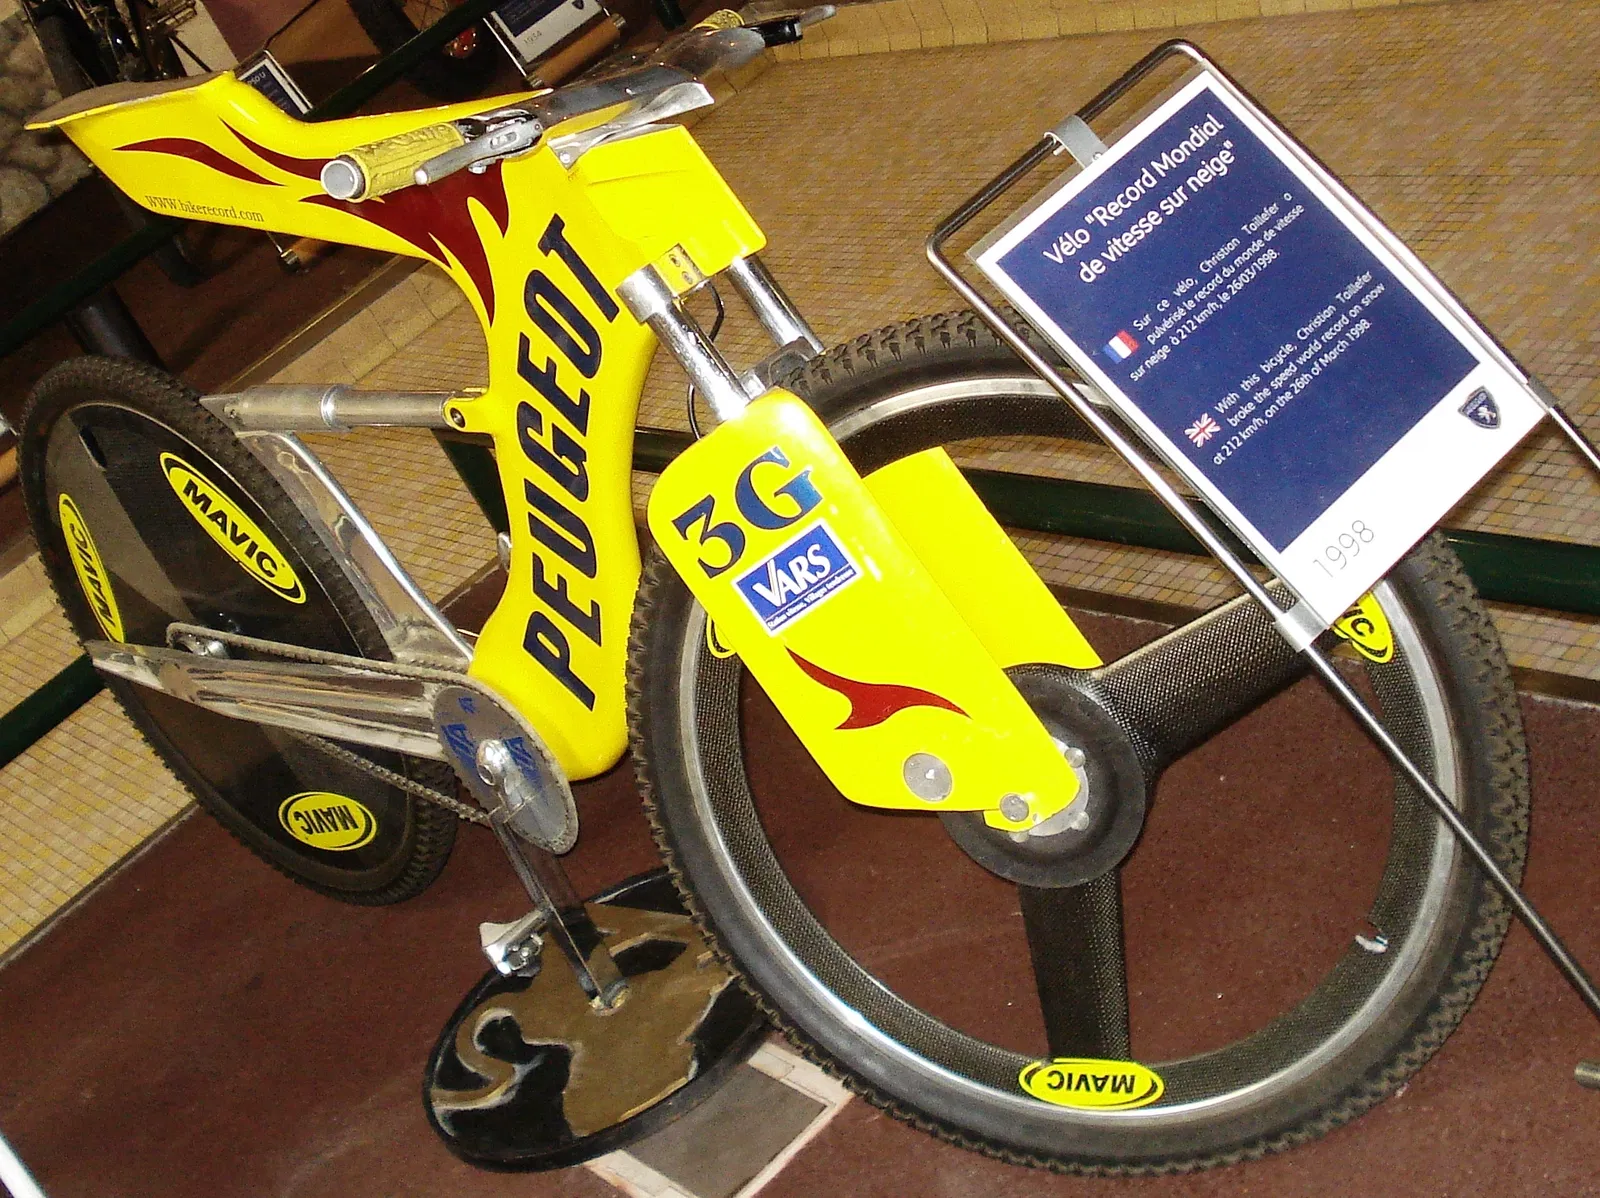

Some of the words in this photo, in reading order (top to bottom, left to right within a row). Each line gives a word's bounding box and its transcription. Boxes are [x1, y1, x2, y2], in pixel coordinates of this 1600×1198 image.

[1043, 229, 1090, 264] Vélo
[1084, 167, 1157, 226] "Record
[1150, 113, 1224, 177] Mondial
[1079, 258, 1106, 283] de
[1101, 210, 1163, 262] vitesse
[1159, 186, 1188, 215] sur
[1186, 140, 1235, 192] neige"
[1130, 365, 1146, 382] sur
[1145, 344, 1171, 369] neige
[1168, 335, 1180, 346] à
[1176, 319, 1198, 341] 212
[1193, 300, 1223, 325] km/h,
[1217, 290, 1231, 303] le
[1227, 248, 1280, 295] 26/03/1998.
[1133, 313, 1152, 331] Sur
[1156, 299, 1170, 312] ce
[1173, 277, 1198, 297] vélo,
[1199, 237, 1240, 273] Christian
[1241, 203, 1279, 235] Taillefer
[1146, 306, 1187, 345] pulvérisé
[1184, 299, 1196, 310] le
[1194, 274, 1224, 302] record
[1222, 266, 1235, 278] du
[1234, 238, 1265, 268] monde
[1263, 229, 1277, 242] de
[1274, 204, 1305, 231] vitesse
[1213, 452, 1227, 466] at
[1222, 435, 1243, 457] 212
[1240, 417, 1269, 441] km/h,
[1264, 403, 1280, 418] on
[1275, 389, 1294, 408] the
[1289, 372, 1314, 396] 26th
[1311, 361, 1323, 376] of
[1319, 338, 1349, 368] March
[1346, 318, 1373, 341] 1998.
[1214, 391, 1240, 414] With
[1240, 371, 1260, 392] this
[1260, 341, 1298, 374] bicycle,
[1296, 304, 1337, 341] Christian
[1335, 270, 1372, 304] Taillefer
[1227, 402, 1256, 428] broke
[1253, 386, 1272, 404] the
[1270, 362, 1298, 390] speed
[1296, 339, 1322, 366] world
[1321, 314, 1350, 343] record
[1348, 304, 1363, 318] on
[1361, 283, 1385, 307] snow
[183, 478, 278, 578] MAVIC
[517, 213, 619, 711] PEUGEOT
[671, 446, 823, 579] 3G
[69, 522, 116, 627] MAVIC
[752, 543, 831, 607] VARS
[1313, 520, 1375, 578] 1998
[291, 804, 359, 834] MAVIC
[1047, 1070, 1136, 1094] MAVIC
